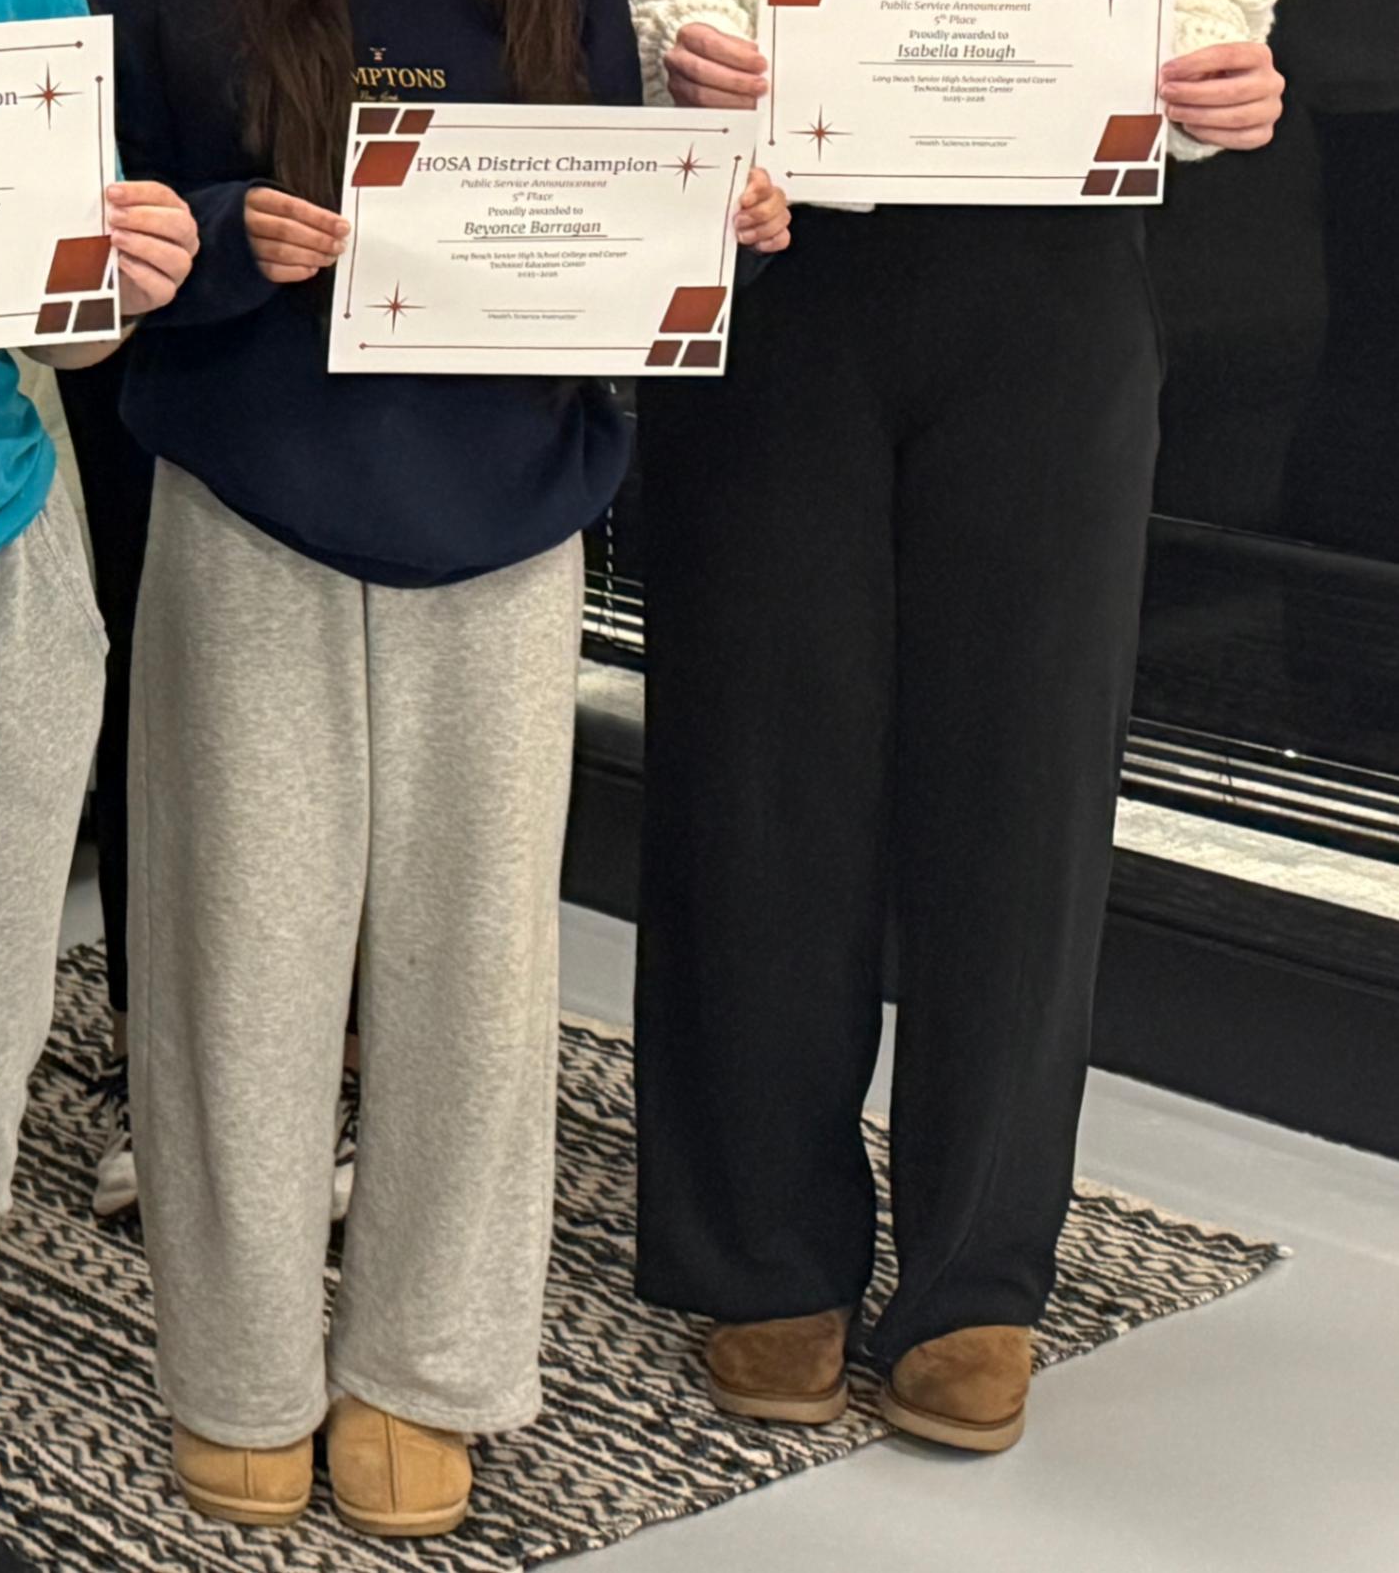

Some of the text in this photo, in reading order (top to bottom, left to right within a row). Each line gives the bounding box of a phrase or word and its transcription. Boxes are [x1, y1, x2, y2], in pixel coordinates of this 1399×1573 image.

[880, 0, 1031, 11] Public Service Announcement
[948, 14, 977, 25] Place
[908, 29, 1009, 41] Proudly awarded to
[897, 43, 1016, 61] Isabella Hough
[349, 67, 447, 90] MPTONS
[416, 156, 658, 176] HOSA District Champion
[460, 178, 607, 188] Public Service Announcement
[487, 205, 584, 218] Proudly awarded to
[463, 220, 602, 236] Beyonce Barragan
